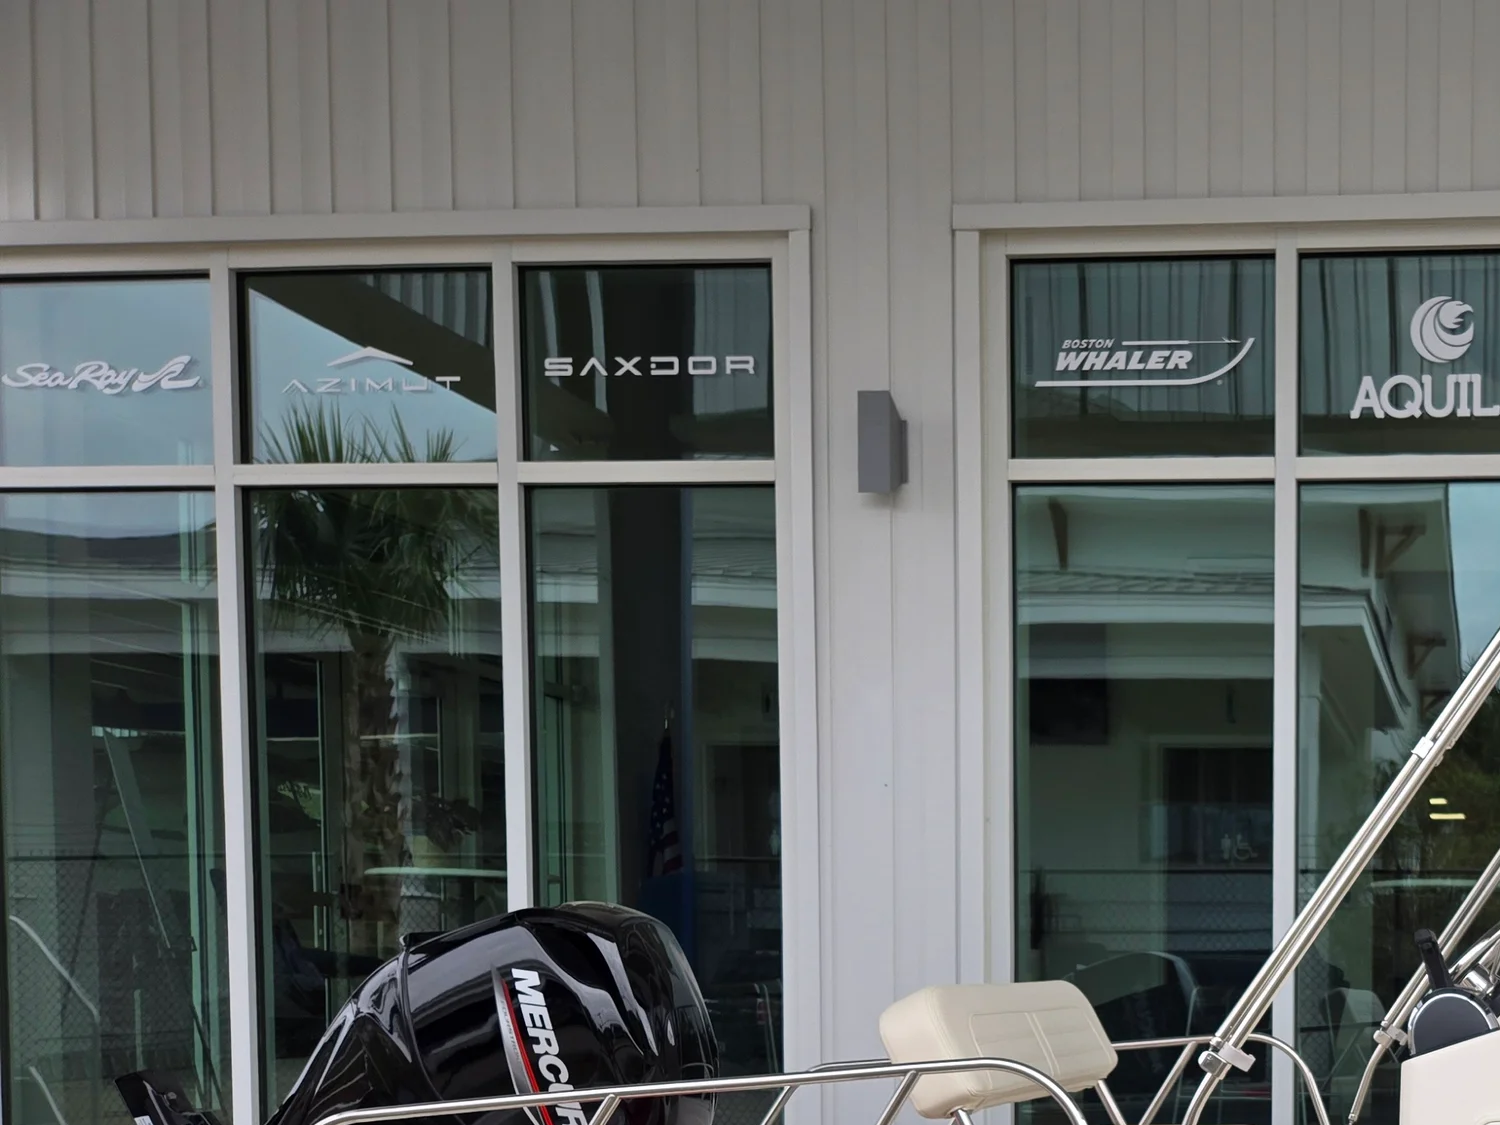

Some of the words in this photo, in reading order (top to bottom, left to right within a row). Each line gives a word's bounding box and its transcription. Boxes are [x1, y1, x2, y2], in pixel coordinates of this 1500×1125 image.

[1061, 338, 1115, 349] BOSTON
[544, 355, 756, 377] SAXDOR
[1055, 350, 1193, 371] WHALER
[1, 362, 73, 388] Sea
[67, 360, 139, 395] Ray
[282, 376, 461, 394] AZIMUT
